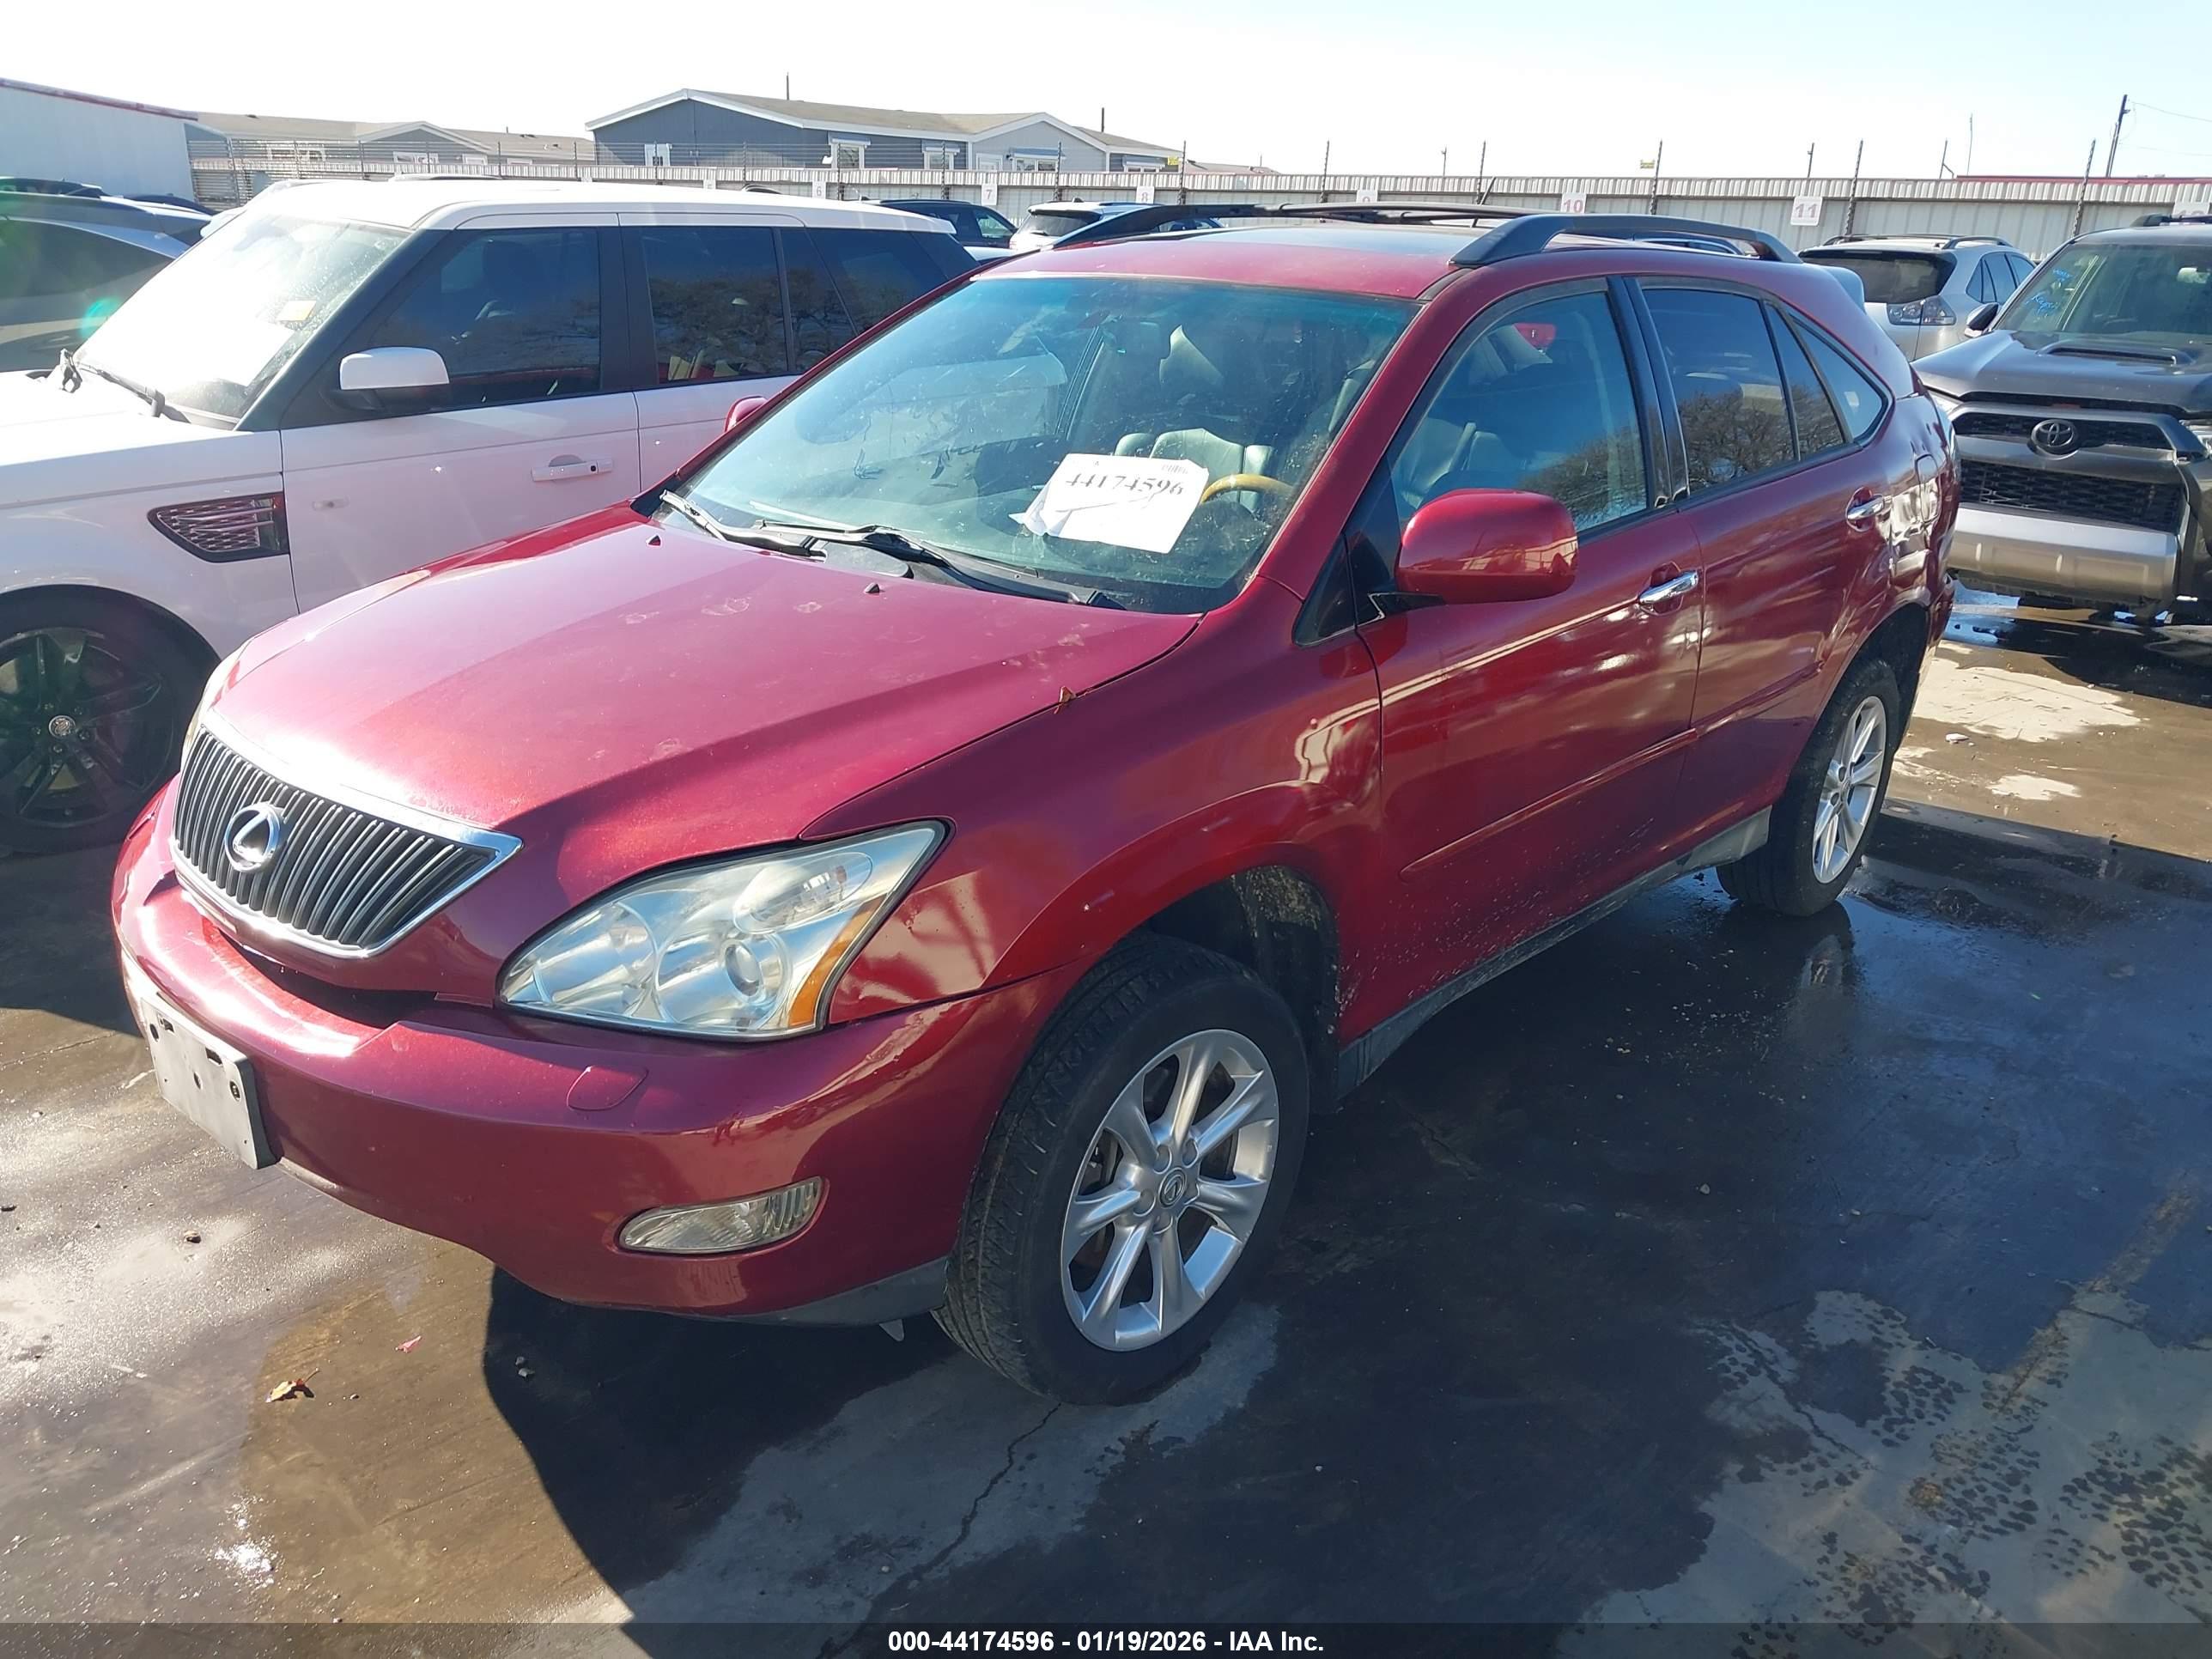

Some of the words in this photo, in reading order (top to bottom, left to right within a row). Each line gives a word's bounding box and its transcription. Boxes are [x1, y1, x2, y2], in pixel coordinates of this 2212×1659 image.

[816, 186, 823, 196] 6
[986, 189, 993, 200] 7
[1563, 199, 1583, 213] 10
[1795, 203, 1818, 218] 11
[1066, 473, 1185, 495] 44174596
